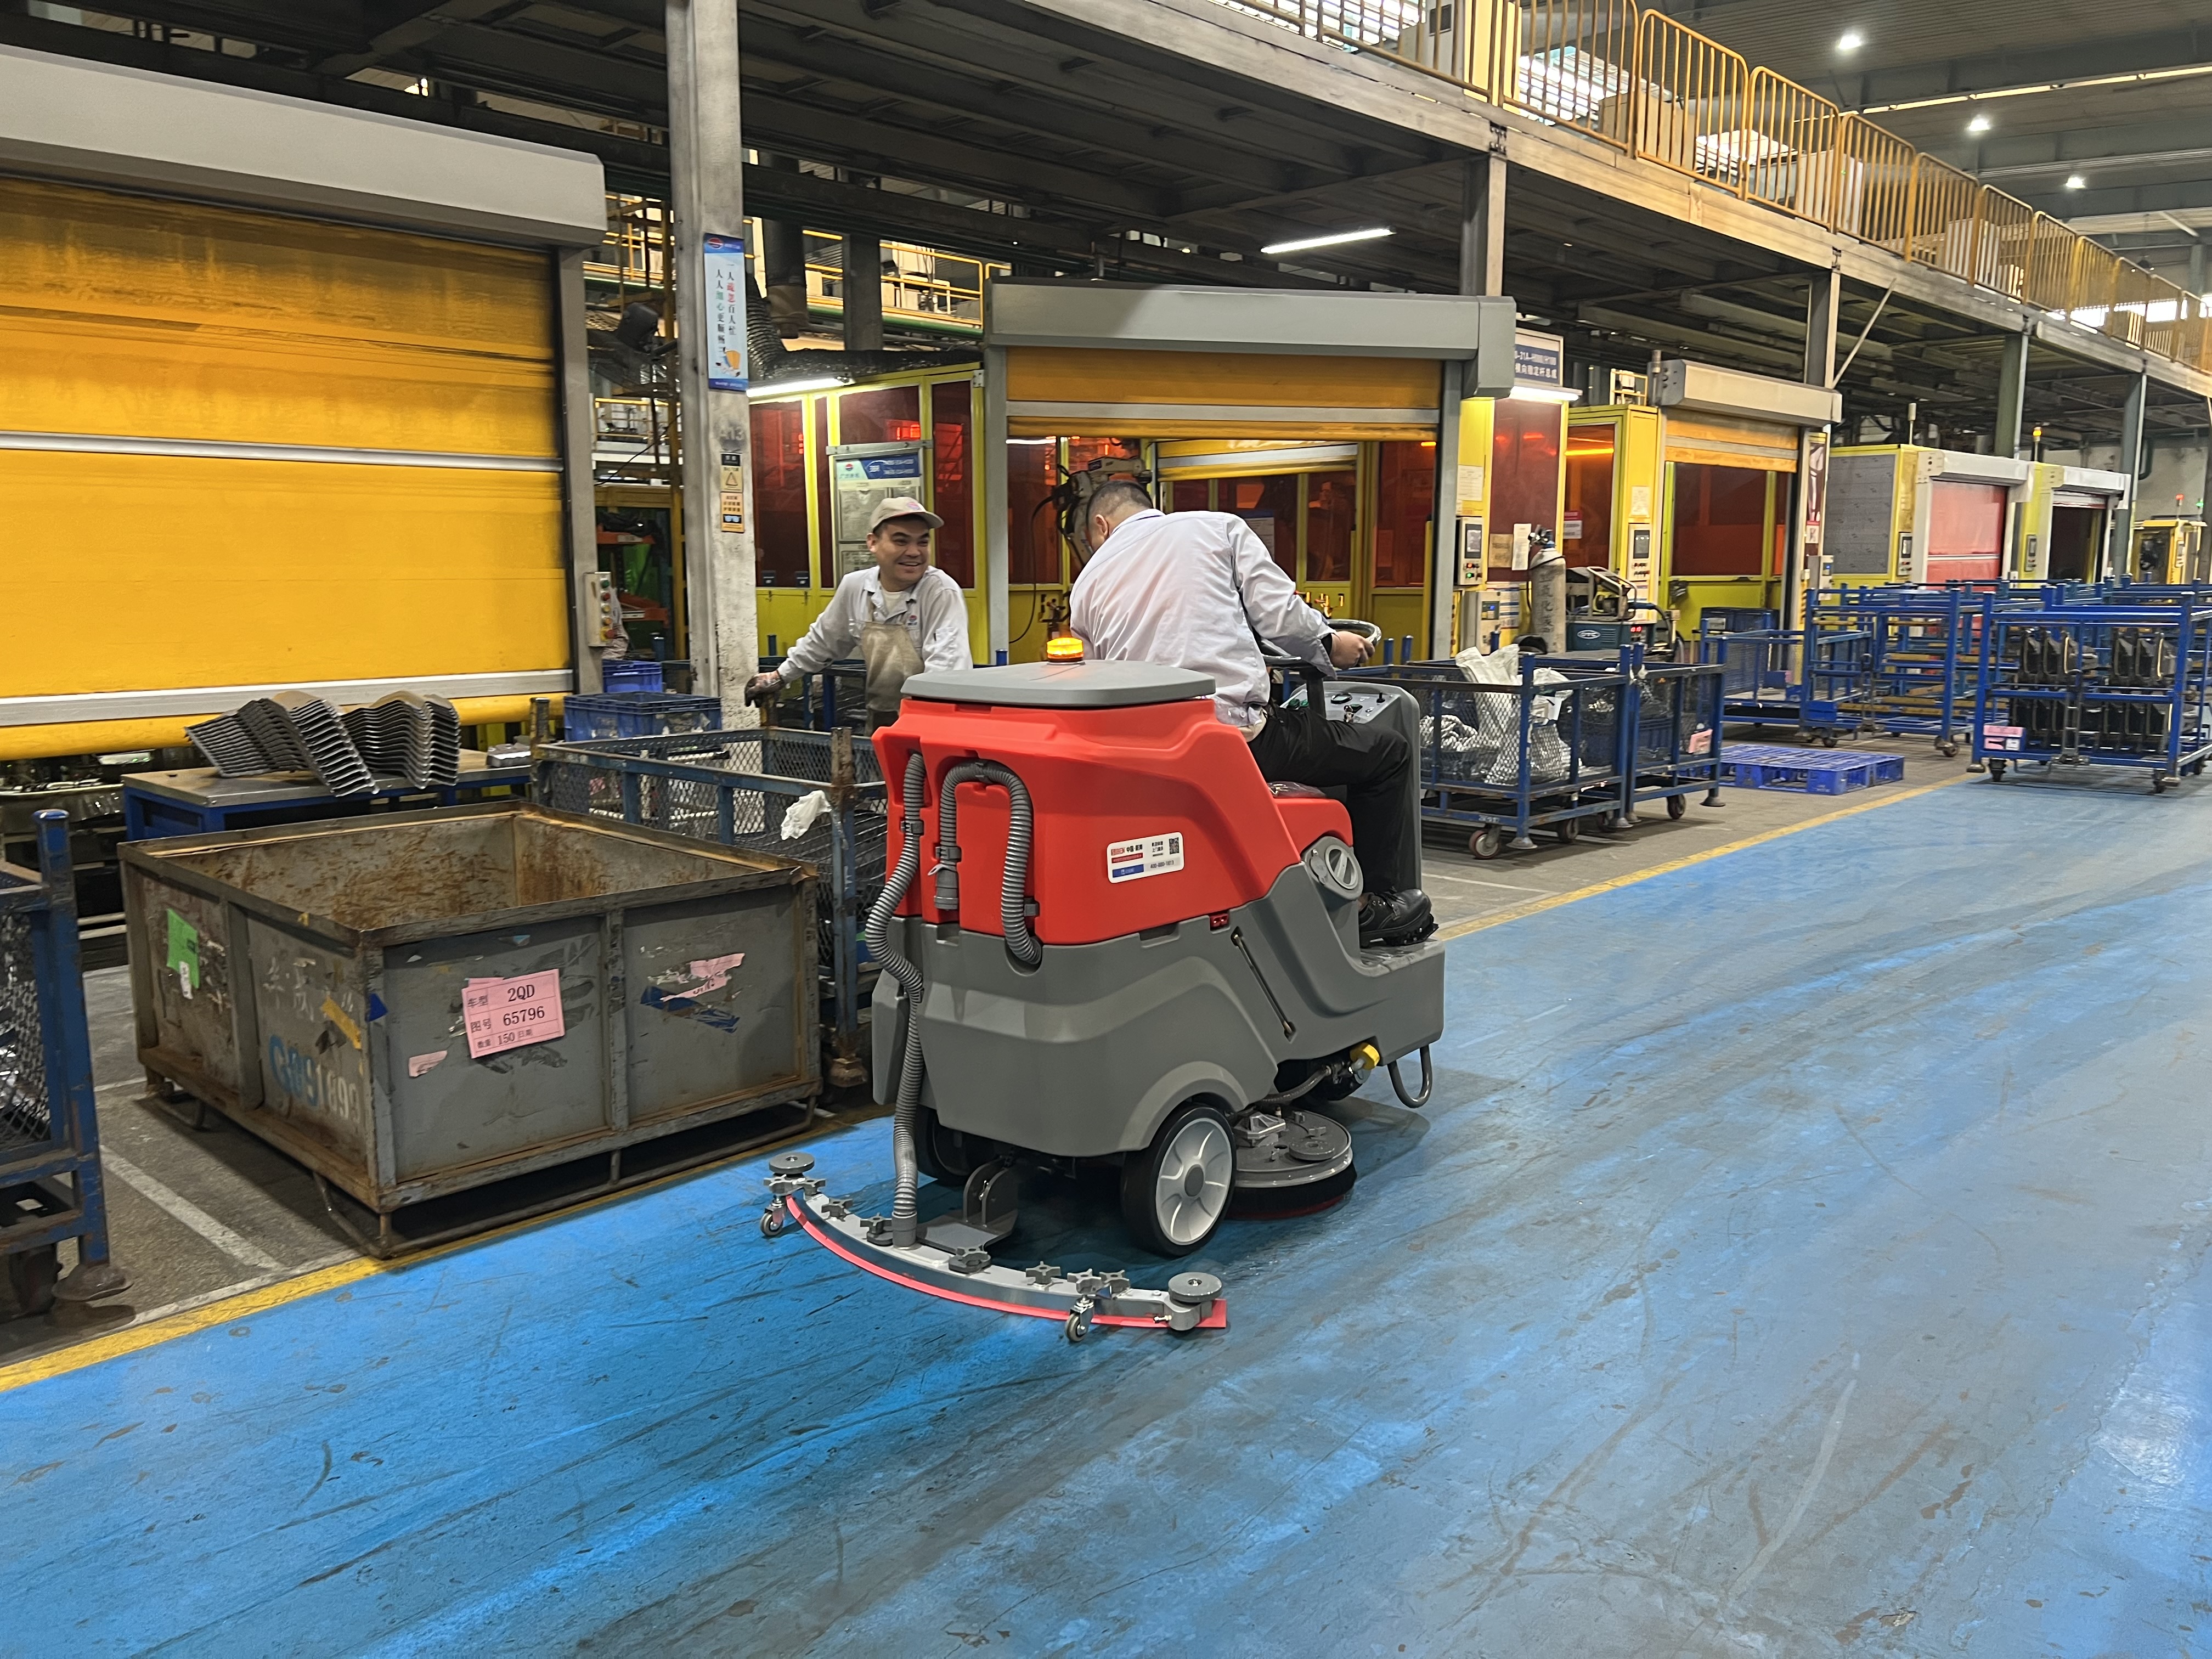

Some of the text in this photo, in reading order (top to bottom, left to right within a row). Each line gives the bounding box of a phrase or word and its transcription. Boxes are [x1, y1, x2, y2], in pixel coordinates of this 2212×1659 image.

[467, 984, 535, 1008] 车型 2QD
[470, 1006, 545, 1034] 图号 65796
[496, 1032, 516, 1045] 150
